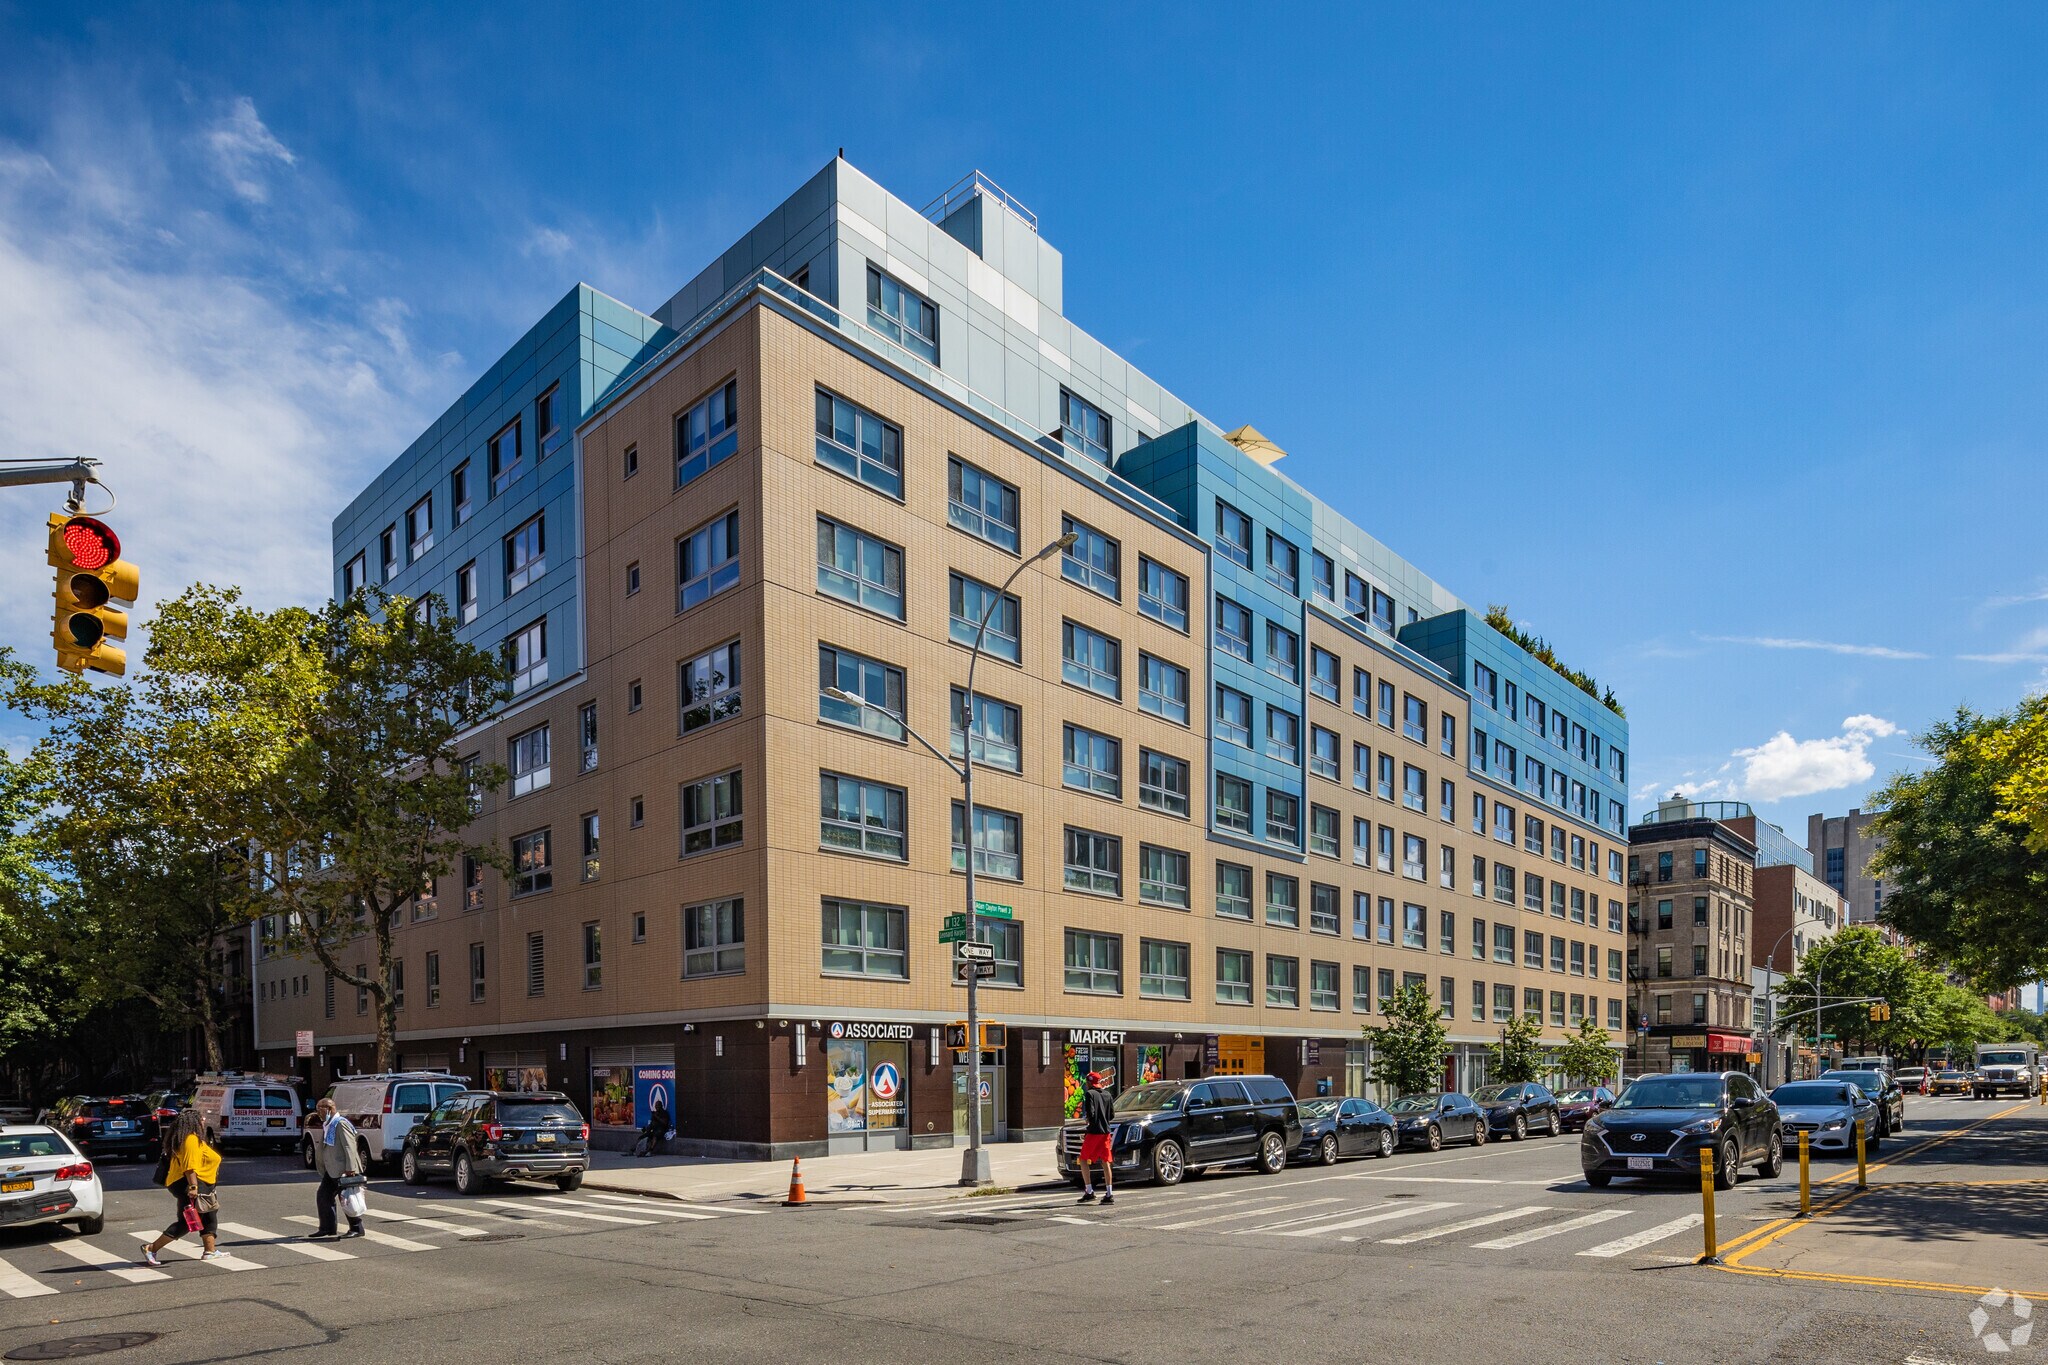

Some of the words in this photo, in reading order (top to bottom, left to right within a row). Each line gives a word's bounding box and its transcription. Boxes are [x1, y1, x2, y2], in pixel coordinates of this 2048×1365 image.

[945, 918, 950, 929] W
[951, 916, 960, 928] 132
[963, 946, 974, 955] ONE
[978, 948, 990, 956] WAY
[845, 1023, 914, 1039] ASSOCIATED
[1070, 1029, 1126, 1045] MARKET
[639, 1069, 661, 1079] COMING
[868, 1108, 906, 1116] SUPERMARKET
